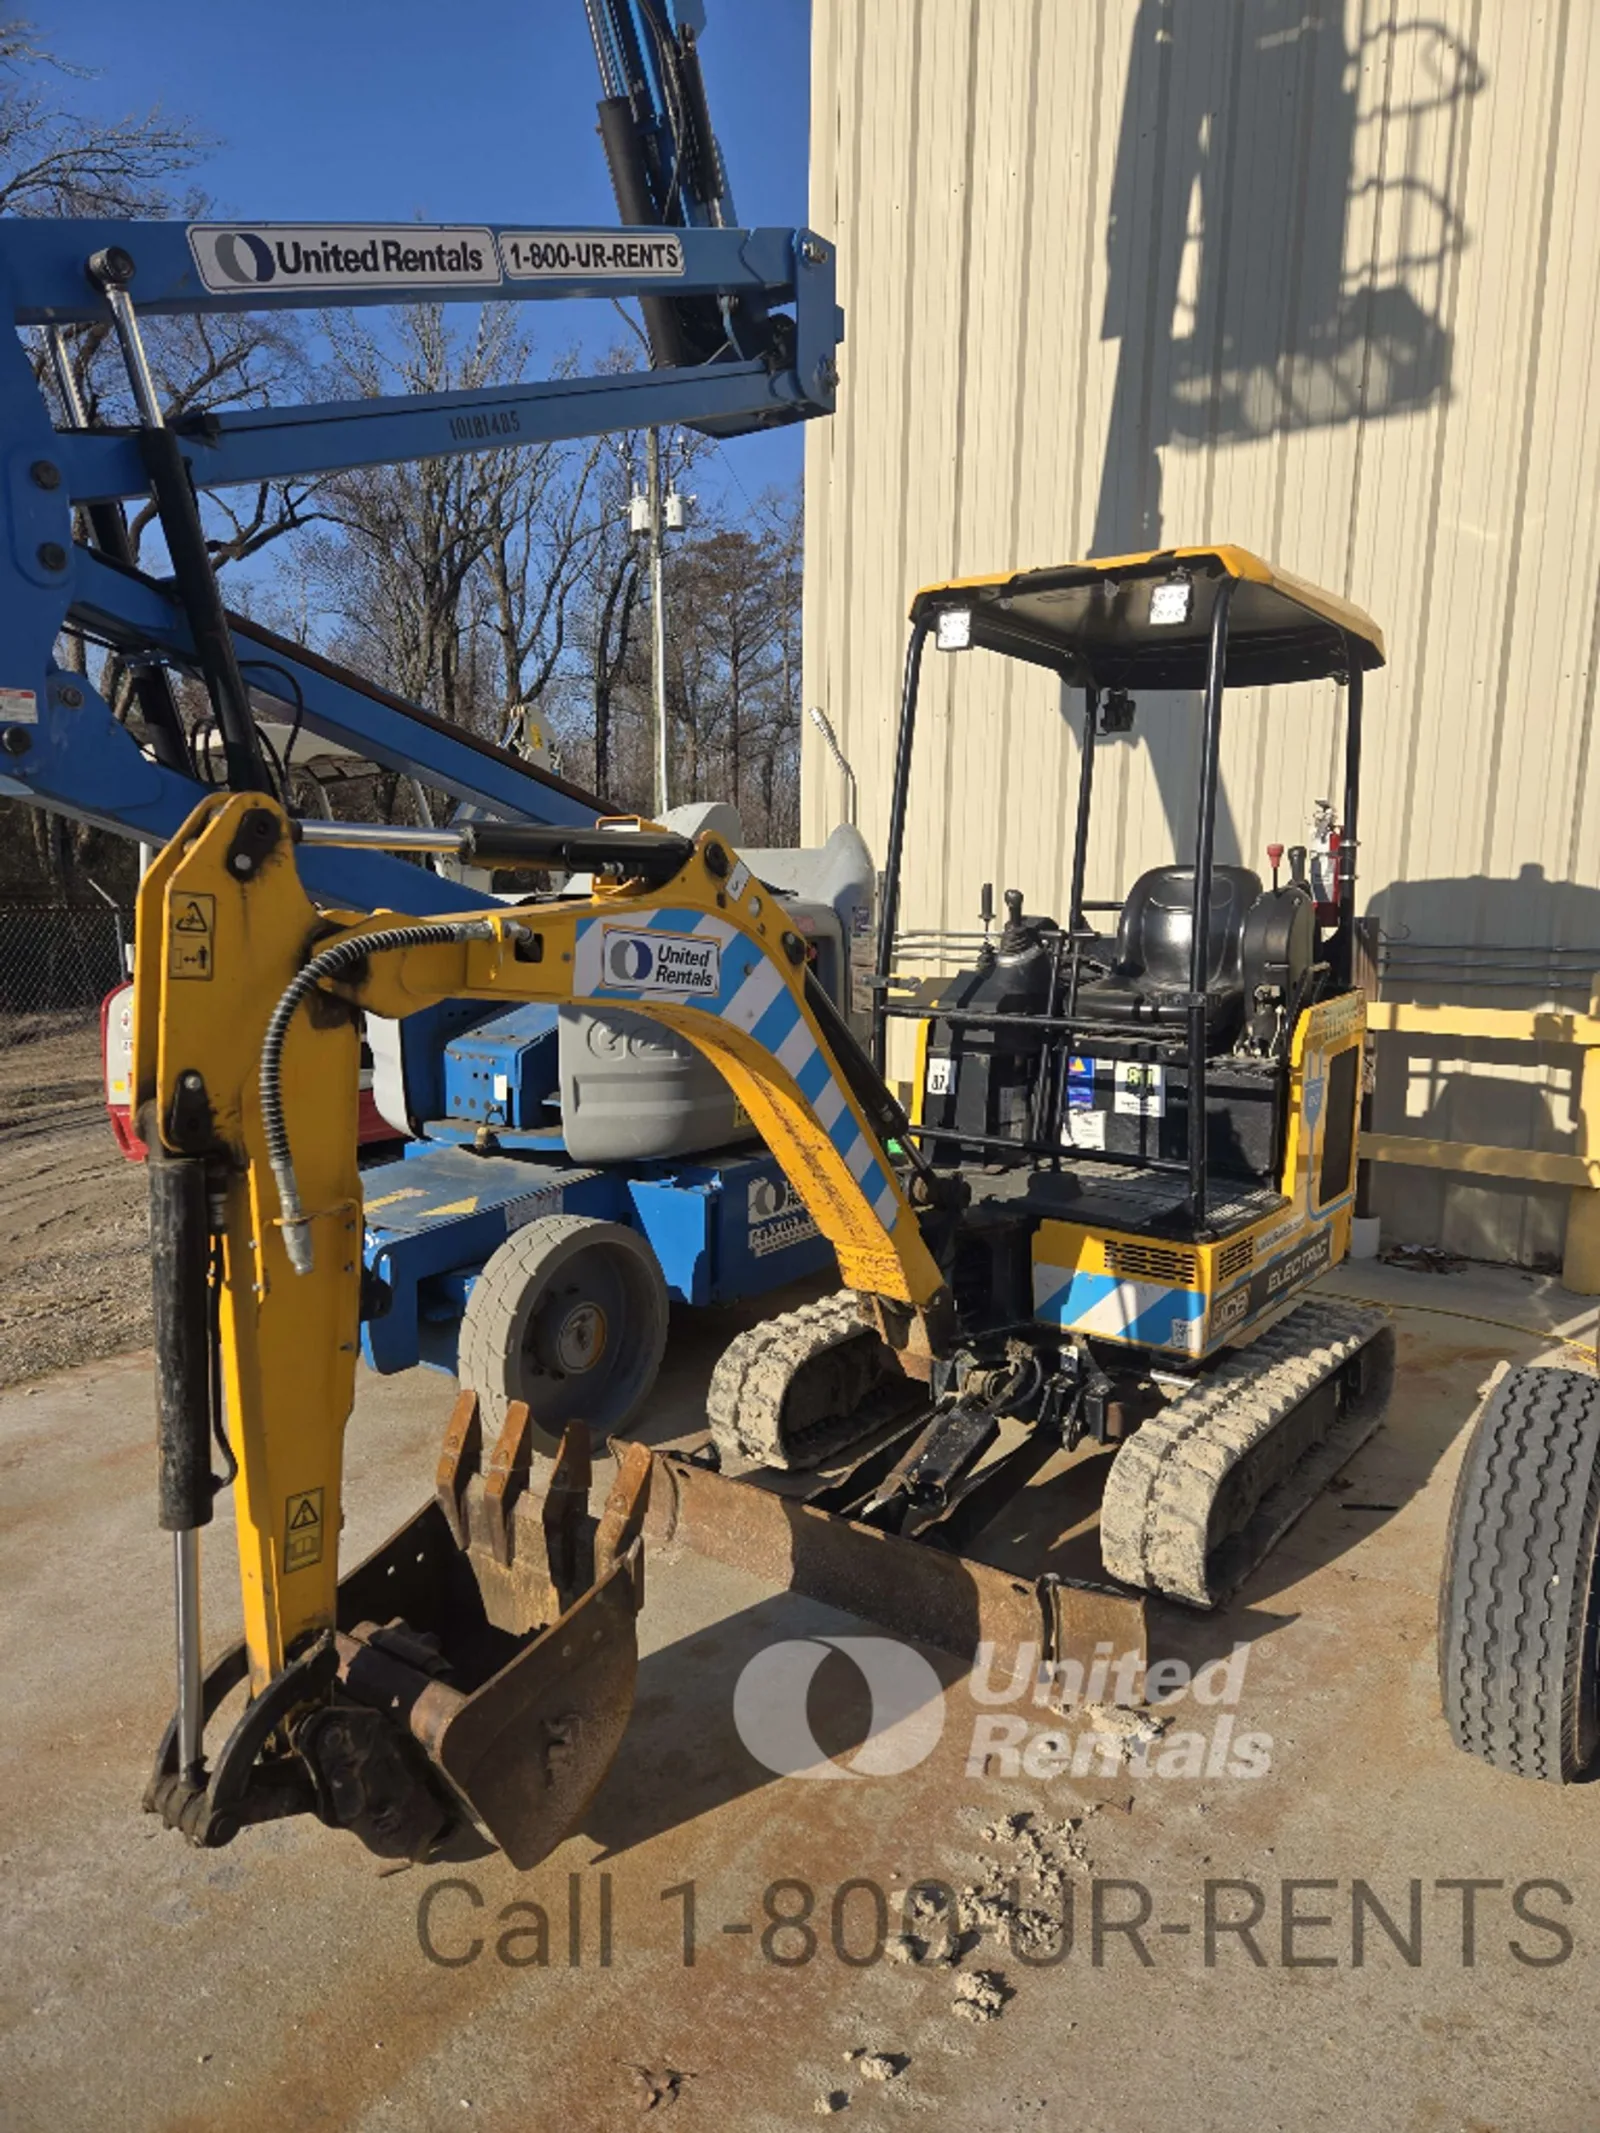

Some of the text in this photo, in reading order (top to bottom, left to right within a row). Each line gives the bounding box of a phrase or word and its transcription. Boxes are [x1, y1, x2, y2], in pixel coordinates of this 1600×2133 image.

[277, 239, 483, 275] United Rentals
[509, 242, 679, 269] 1-800-UR-RENTS
[658, 944, 711, 967] United
[656, 965, 712, 986] Rentals
[1266, 1237, 1328, 1294] ELECTRIC
